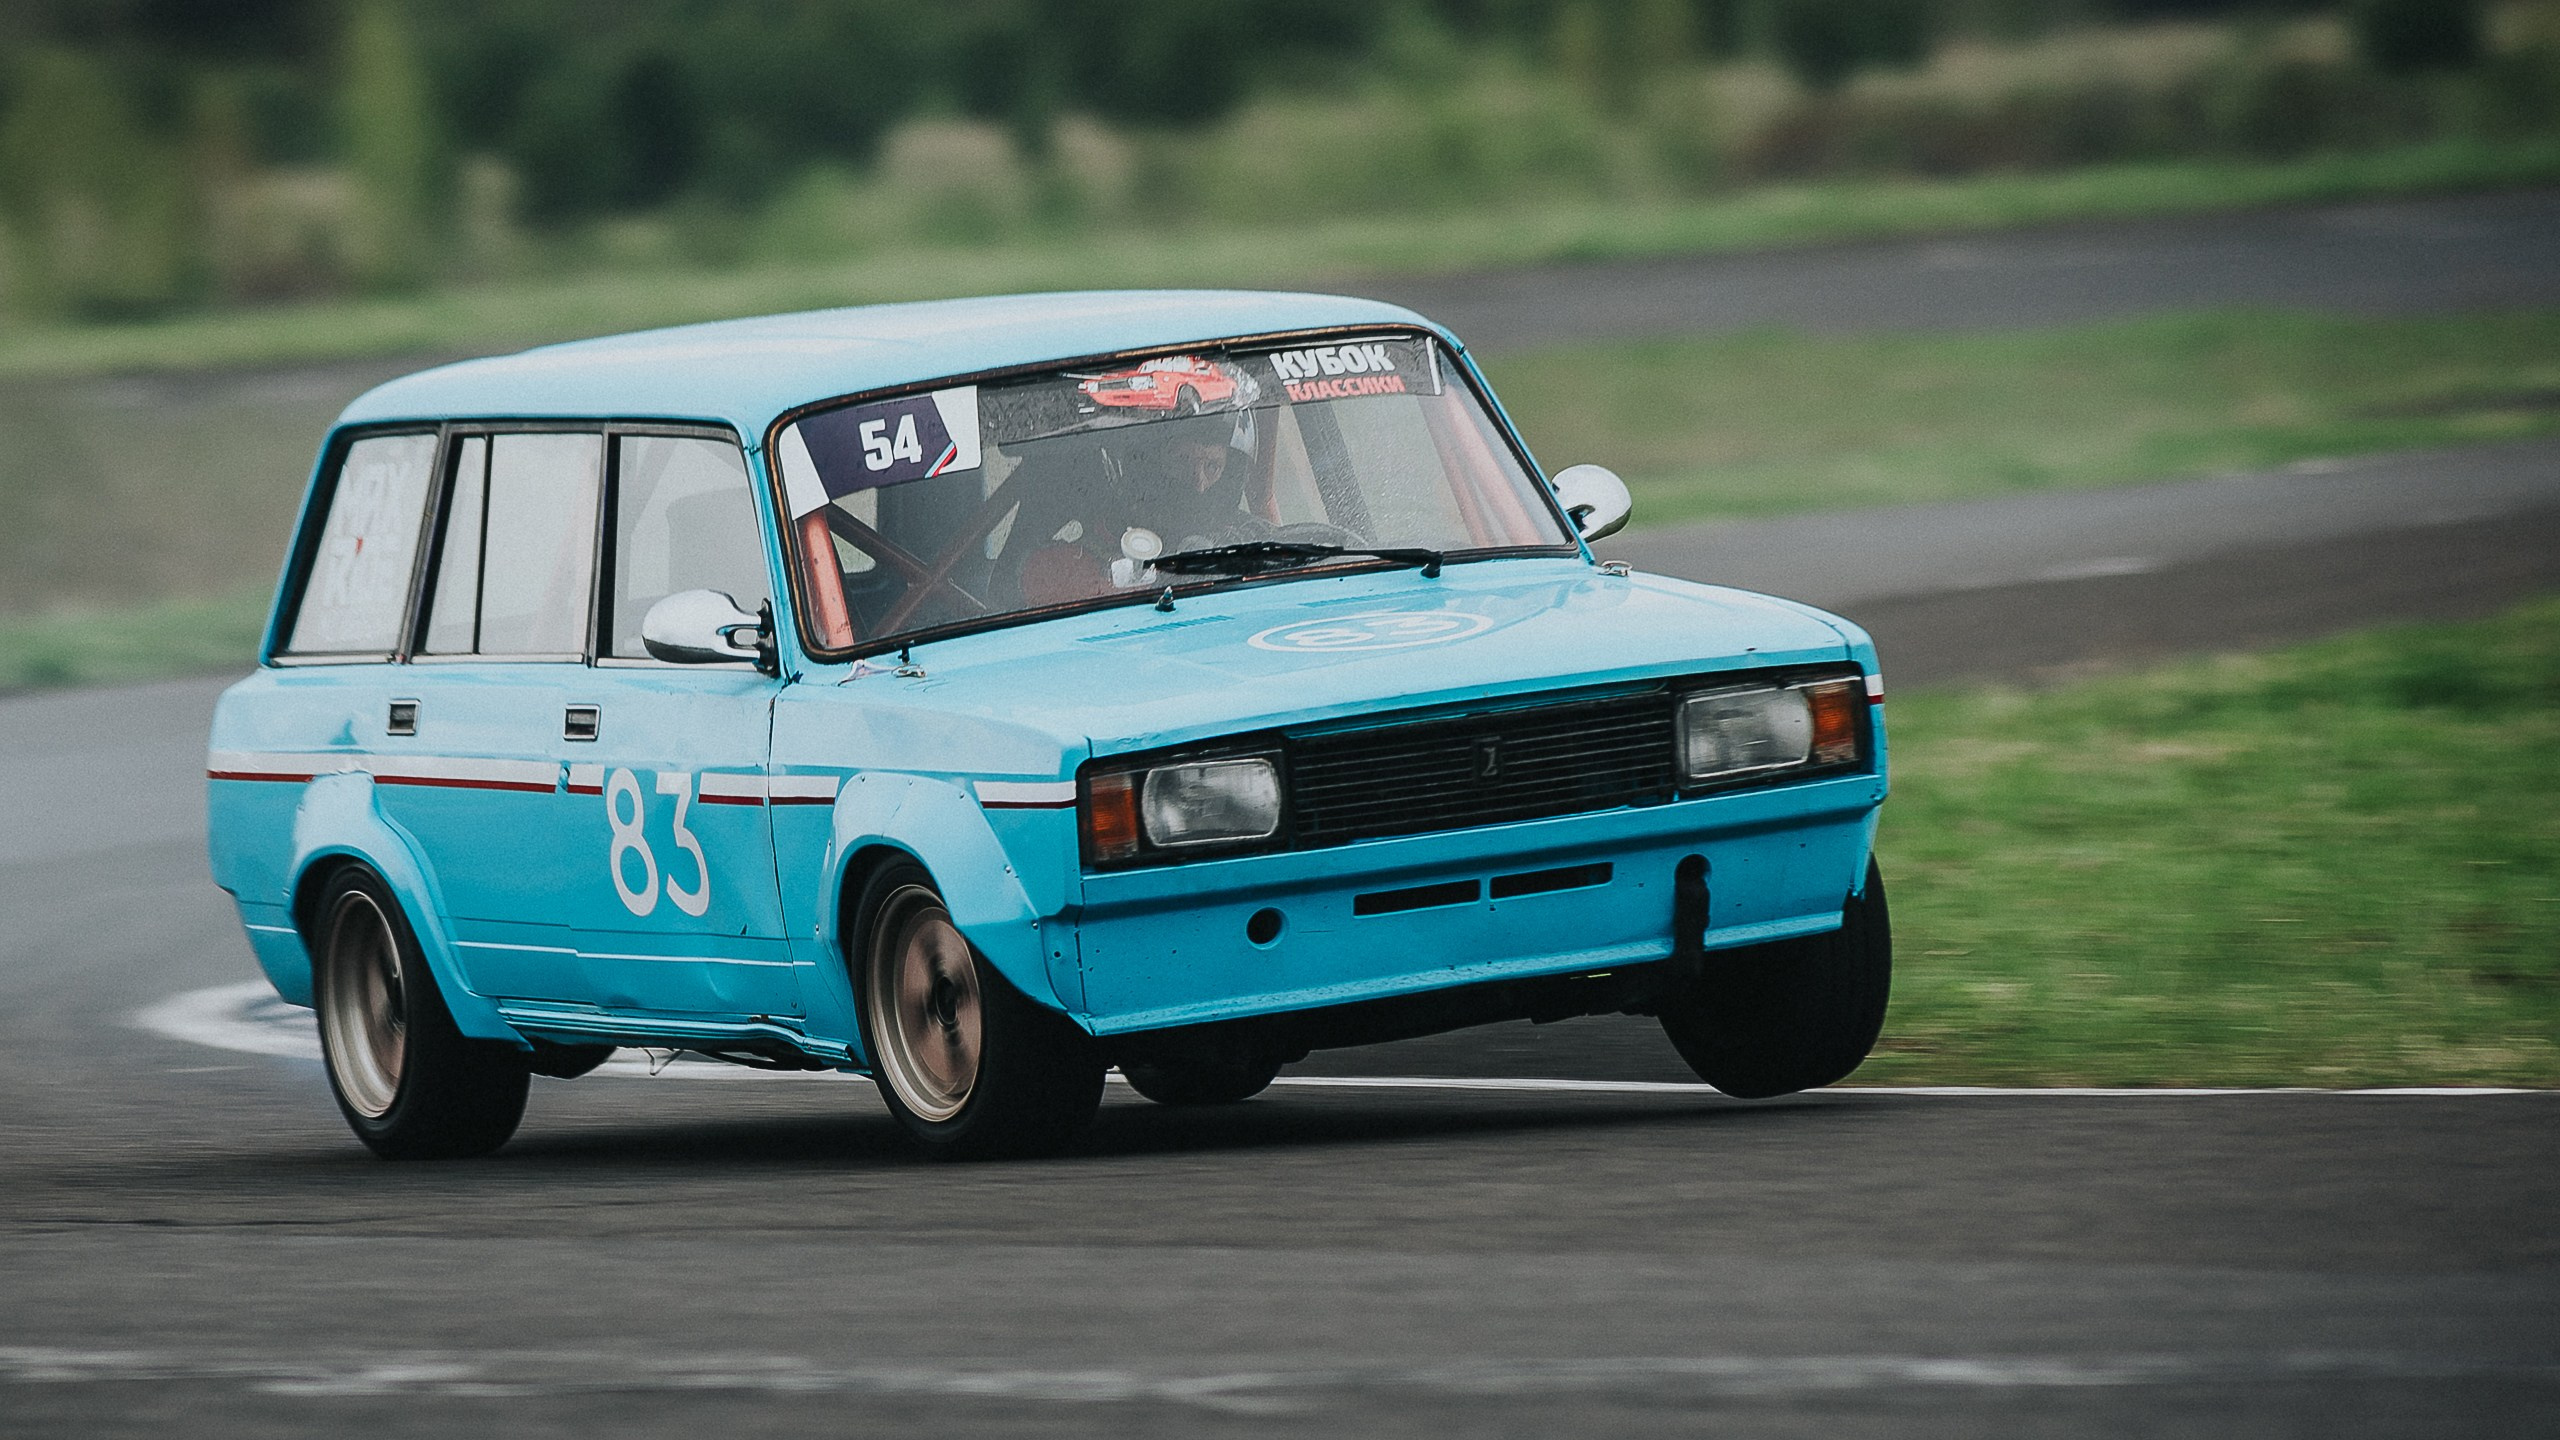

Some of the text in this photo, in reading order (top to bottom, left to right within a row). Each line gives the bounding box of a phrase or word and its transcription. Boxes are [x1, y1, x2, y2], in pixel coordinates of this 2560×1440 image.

[1269, 344, 1396, 380] КУБОК
[1285, 374, 1406, 402] КЛАССИКИ
[858, 413, 923, 472] 54
[1284, 615, 1461, 647] 83
[606, 767, 710, 917] 83
